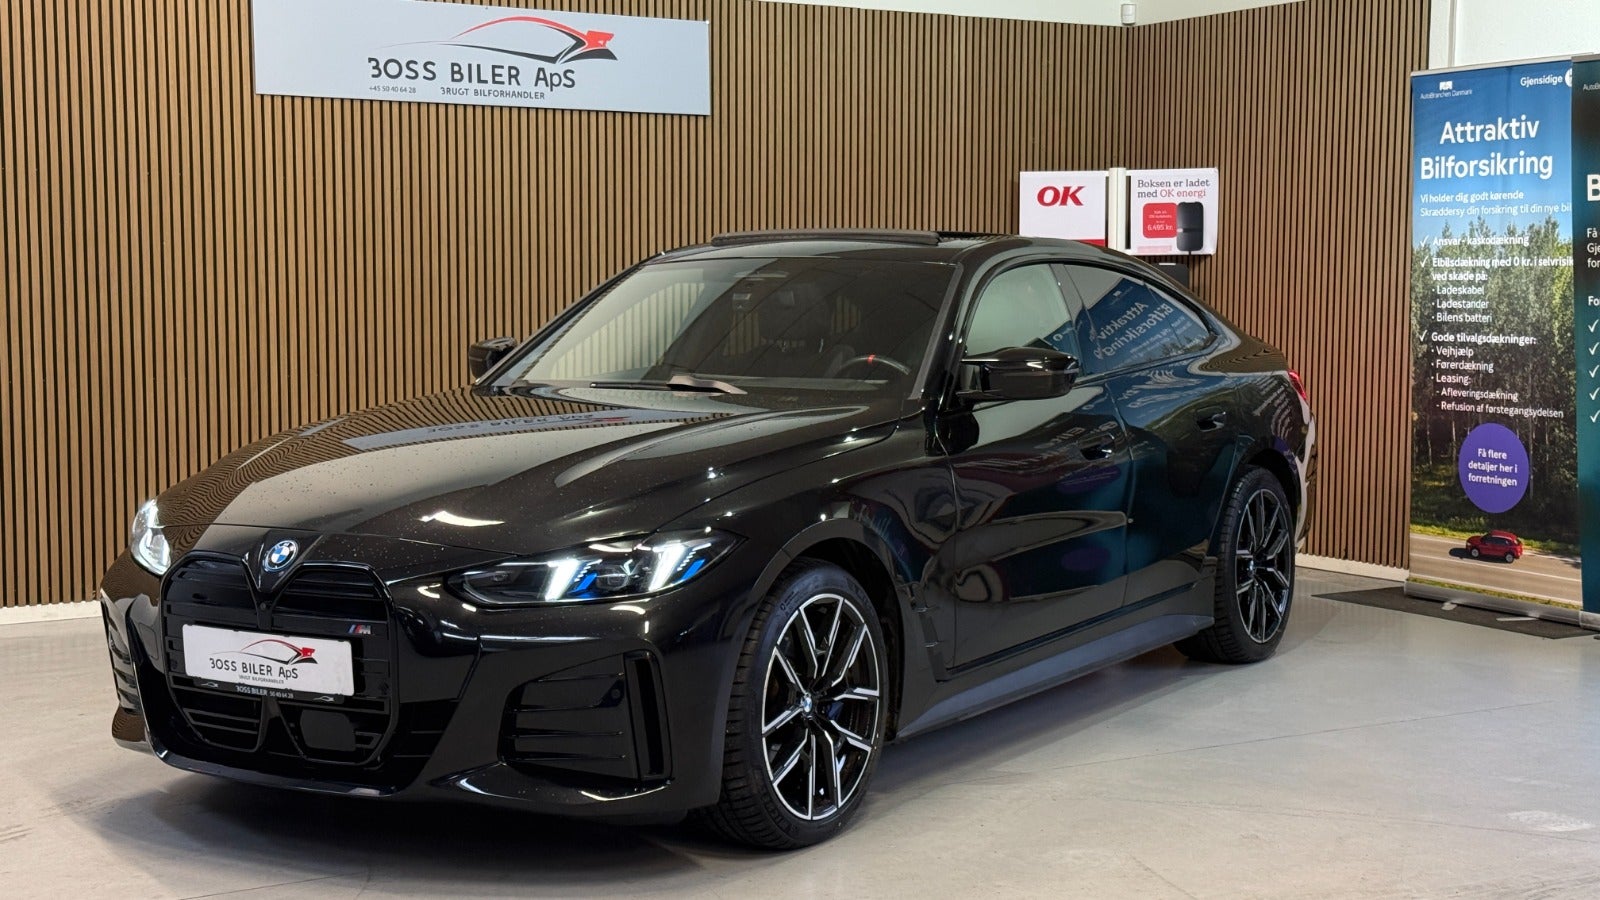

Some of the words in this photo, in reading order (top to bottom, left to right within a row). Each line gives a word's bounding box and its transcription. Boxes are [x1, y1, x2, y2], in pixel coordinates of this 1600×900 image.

[450, 62, 520, 86] BILER
[534, 67, 576, 92] ApS
[1520, 74, 1563, 88] Gjensidige
[474, 88, 545, 100] BILFORHANDLER
[1452, 89, 1472, 97] Danmark
[1440, 114, 1539, 145] Attraktiv
[1421, 150, 1552, 180] Bilforsikring
[1137, 179, 1171, 188] Boksen
[1186, 178, 1210, 187] ladet
[1037, 186, 1085, 207] OK
[1137, 189, 1158, 198] med
[1160, 189, 1175, 198] OK
[1176, 188, 1206, 199] energi
[1421, 194, 1428, 203] Vi
[1429, 193, 1454, 202] holder
[1455, 192, 1468, 203] dig
[1470, 191, 1488, 203] godt
[1490, 190, 1524, 200] kørende
[1421, 207, 1464, 218] Skræddersy
[1466, 205, 1480, 215] din
[1481, 204, 1519, 216] forsikring
[1520, 204, 1529, 214] til
[1530, 203, 1542, 213] din
[1544, 204, 1559, 215] nye
[1587, 227, 1598, 239] Få
[1467, 234, 1529, 247] kaskodækning
[1432, 257, 1490, 269] Elbilsdækning
[1491, 256, 1511, 268] med
[1513, 256, 1520, 266] 0
[1521, 256, 1533, 266] kr.
[1432, 271, 1447, 280] ved
[1448, 271, 1474, 281] skade
[1475, 271, 1488, 282] på:
[1436, 285, 1485, 295] Ladeskabel
[1436, 298, 1489, 309] Ladestander
[1436, 312, 1463, 322] Bilens
[1464, 312, 1493, 323] batteri
[1431, 331, 1455, 342] Gode
[1456, 333, 1537, 347] tilvalgsdækninger:
[1436, 345, 1474, 358] Vejhjælp
[1436, 359, 1494, 373] Førerdækning
[1436, 372, 1472, 386] Leasing:
[1440, 387, 1519, 402] Afleveringsdækning
[1440, 401, 1475, 412] Refusion
[1476, 403, 1484, 413] af
[1485, 404, 1564, 418] førstegangsydelsen
[1477, 447, 1487, 458] Få
[1488, 448, 1507, 460] flere
[1468, 460, 1498, 473] detaljer
[1499, 463, 1513, 473] her
[1514, 463, 1518, 473] i
[1468, 472, 1518, 487] forretningen
[241, 662, 272, 677] BILER
[278, 666, 298, 680] ApS
[251, 687, 268, 697] BILER
